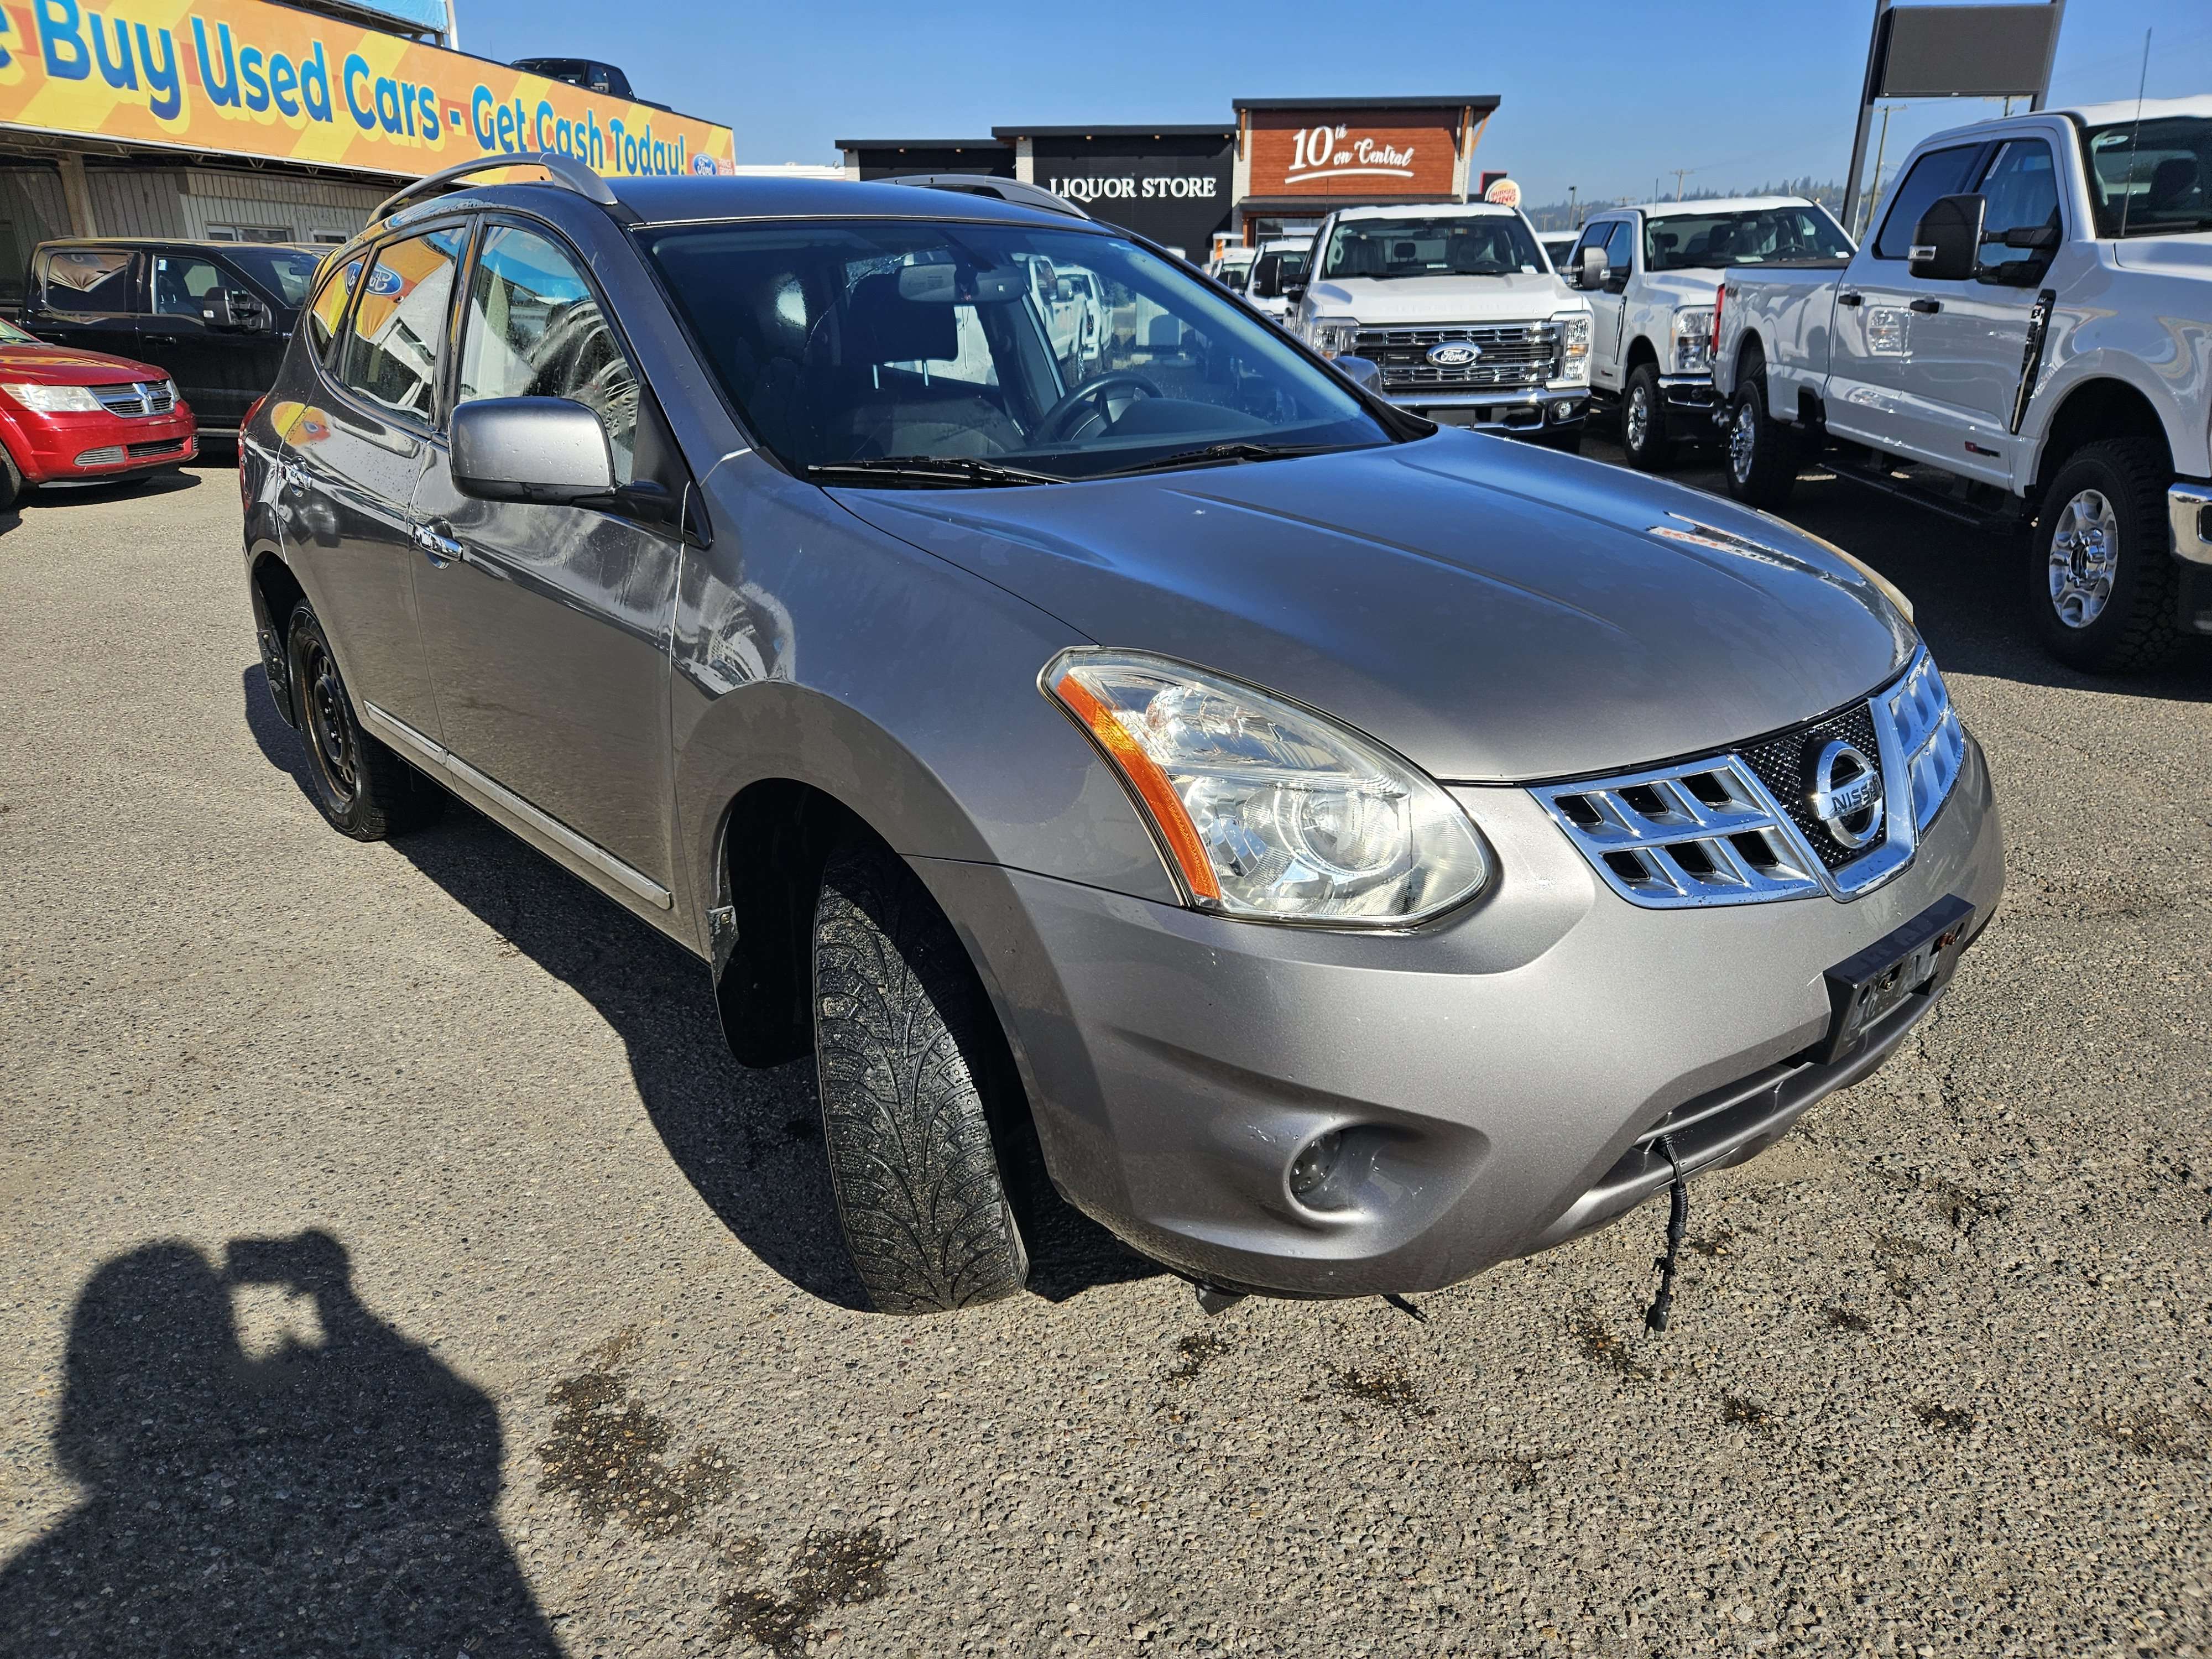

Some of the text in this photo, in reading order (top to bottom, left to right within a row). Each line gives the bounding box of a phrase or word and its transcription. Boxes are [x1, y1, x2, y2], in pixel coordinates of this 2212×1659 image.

[34, 0, 181, 120] Buy
[191, 16, 333, 123] Used
[343, 53, 440, 141] Cars
[472, 85, 527, 153] Get
[536, 100, 603, 169] Cash
[1288, 123, 1414, 170] 10th on Central
[697, 157, 713, 176] Ford
[1049, 178, 1217, 203] LIQUOR STORE
[1440, 349, 1469, 362] Ford
